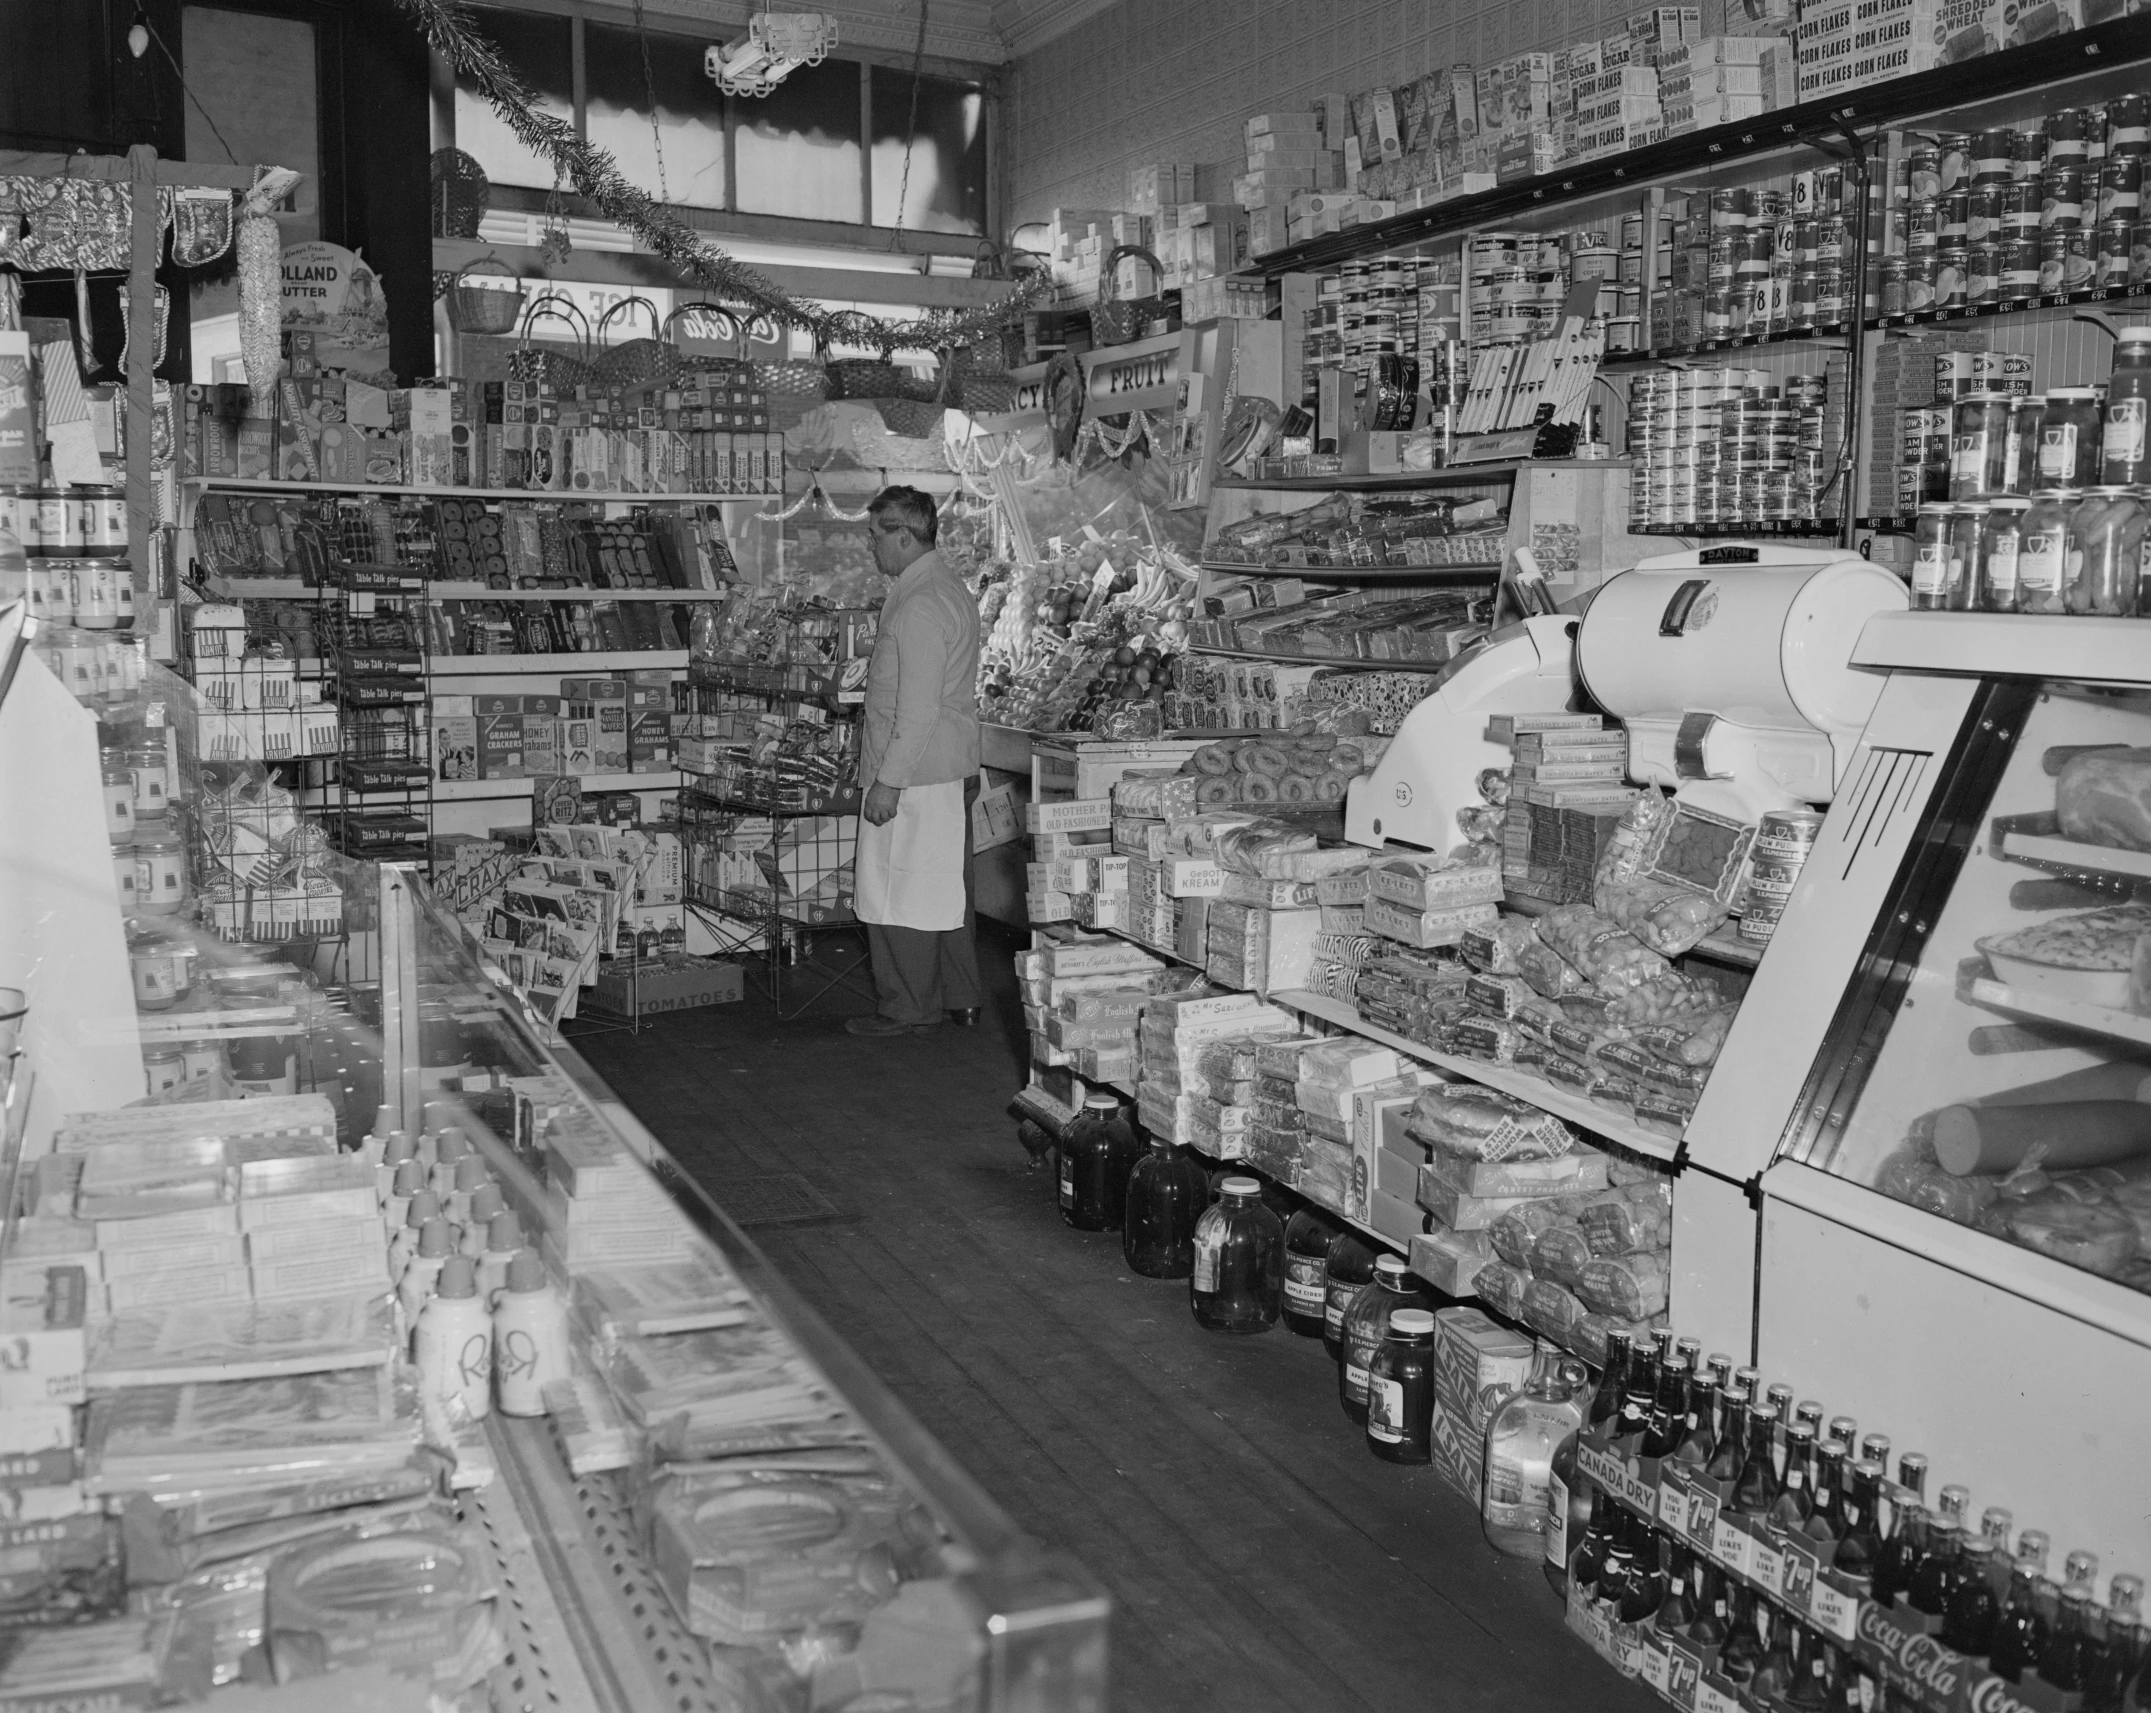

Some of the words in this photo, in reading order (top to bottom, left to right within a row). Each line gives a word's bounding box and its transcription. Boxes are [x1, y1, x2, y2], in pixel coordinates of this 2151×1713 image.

[1858, 1, 1878, 20] CORN
[1799, 21, 1819, 40] CORN
[1821, 10, 1849, 36] FLAKES
[1946, 10, 1985, 31] WHEAT
[1630, 22, 1653, 38] ALL-BRAN
[1855, 32, 1876, 49] CORN
[1879, 20, 1910, 42] FLAKES
[1801, 46, 1819, 65] CORN
[1822, 38, 1851, 60] FLAKES
[1602, 50, 1630, 69] SUGAR
[1855, 60, 1875, 77] CORN
[1877, 49, 1908, 70] FLAKES
[1569, 62, 1596, 81] SUGAR
[1801, 72, 1820, 91] CORN
[1823, 64, 1851, 85] FLAKES
[1579, 80, 1595, 98] CORN
[1598, 71, 1622, 92] FLAKES
[1579, 108, 1595, 126] CORN
[1597, 100, 1620, 120] FLAKES
[1580, 134, 1597, 152] CORN
[1600, 126, 1625, 146] FLAKES
[1629, 131, 1647, 149] CORN
[308, 244, 326, 252] Fresh
[311, 253, 334, 263] Sweet
[1110, 358, 1169, 394] FRUIT
[284, 382, 302, 427] NOBILITY
[210, 421, 220, 474] ARROWROOT
[299, 423, 319, 479] ASSORTMENT
[1707, 549, 1750, 559] DAYTON
[356, 572, 372, 583] table
[372, 572, 385, 583] talk
[387, 574, 399, 585] pies
[353, 659, 370, 670] table
[371, 659, 384, 670] talk
[385, 660, 398, 671] pies
[360, 688, 375, 698] table
[377, 688, 389, 698] talk
[390, 689, 402, 699] pies
[489, 731, 520, 740] GRAHAM
[523, 727, 550, 738] HONEY
[642, 727, 664, 735] HONEY
[487, 740, 522, 749] CRACKERS
[635, 736, 669, 744] GRAHAMS
[266, 749, 291, 760] ARNOLD
[313, 742, 338, 754] ARNOLD
[364, 774, 379, 784] table
[380, 773, 393, 784] talk
[394, 774, 406, 785] pies
[555, 807, 572, 818] RITZ
[1052, 804, 1096, 818] MOTHER
[1046, 820, 1060, 829] OLD
[1063, 816, 1107, 829] FASHIONED
[362, 830, 377, 840] table
[379, 829, 391, 840] talk
[392, 830, 405, 841] pies
[1060, 849, 1073, 857] OLD
[1105, 863, 1126, 871] TIP-TOP
[459, 861, 502, 904] CRAX
[1182, 878, 1220, 889] KREAM
[309, 888, 333, 897] COOKIES
[1051, 908, 1070, 919] OLD
[1087, 955, 1113, 968] English
[1114, 952, 1142, 966] Muffins
[638, 989, 737, 1013] TOMATOES
[1104, 1003, 1134, 1017] English
[1484, 1120, 1512, 1150] ROLLS
[1485, 1124, 1516, 1157] ENRICHED
[1355, 1164, 1364, 1199] LIFE
[1287, 1285, 1302, 1296] APPLE
[1303, 1290, 1323, 1298] CIDER
[1351, 1372, 1368, 1382] APPLE
[1446, 1351, 1476, 1417] SALE
[1445, 1431, 1476, 1499] SALE
[1578, 1447, 1624, 1492] CANADA
[1626, 1478, 1653, 1508] DRY
[1667, 1494, 1680, 1505] YOU
[1665, 1503, 1681, 1515] LIKE
[1669, 1513, 1677, 1523] IT
[1727, 1529, 1735, 1539] IT
[1719, 1538, 1742, 1551] LIKES
[1722, 1550, 1739, 1562] YOU
[1759, 1551, 1774, 1563] YOU
[1756, 1562, 1775, 1573] LIKE
[1762, 1571, 1770, 1582] IT
[1825, 1592, 1835, 1602] IT
[1817, 1602, 1842, 1616] LIKES
[1821, 1615, 1838, 1626] YOU
[1645, 1661, 1662, 1674] LIKE
[1650, 1672, 1658, 1682] IT
[1708, 1691, 1717, 1701] IT
